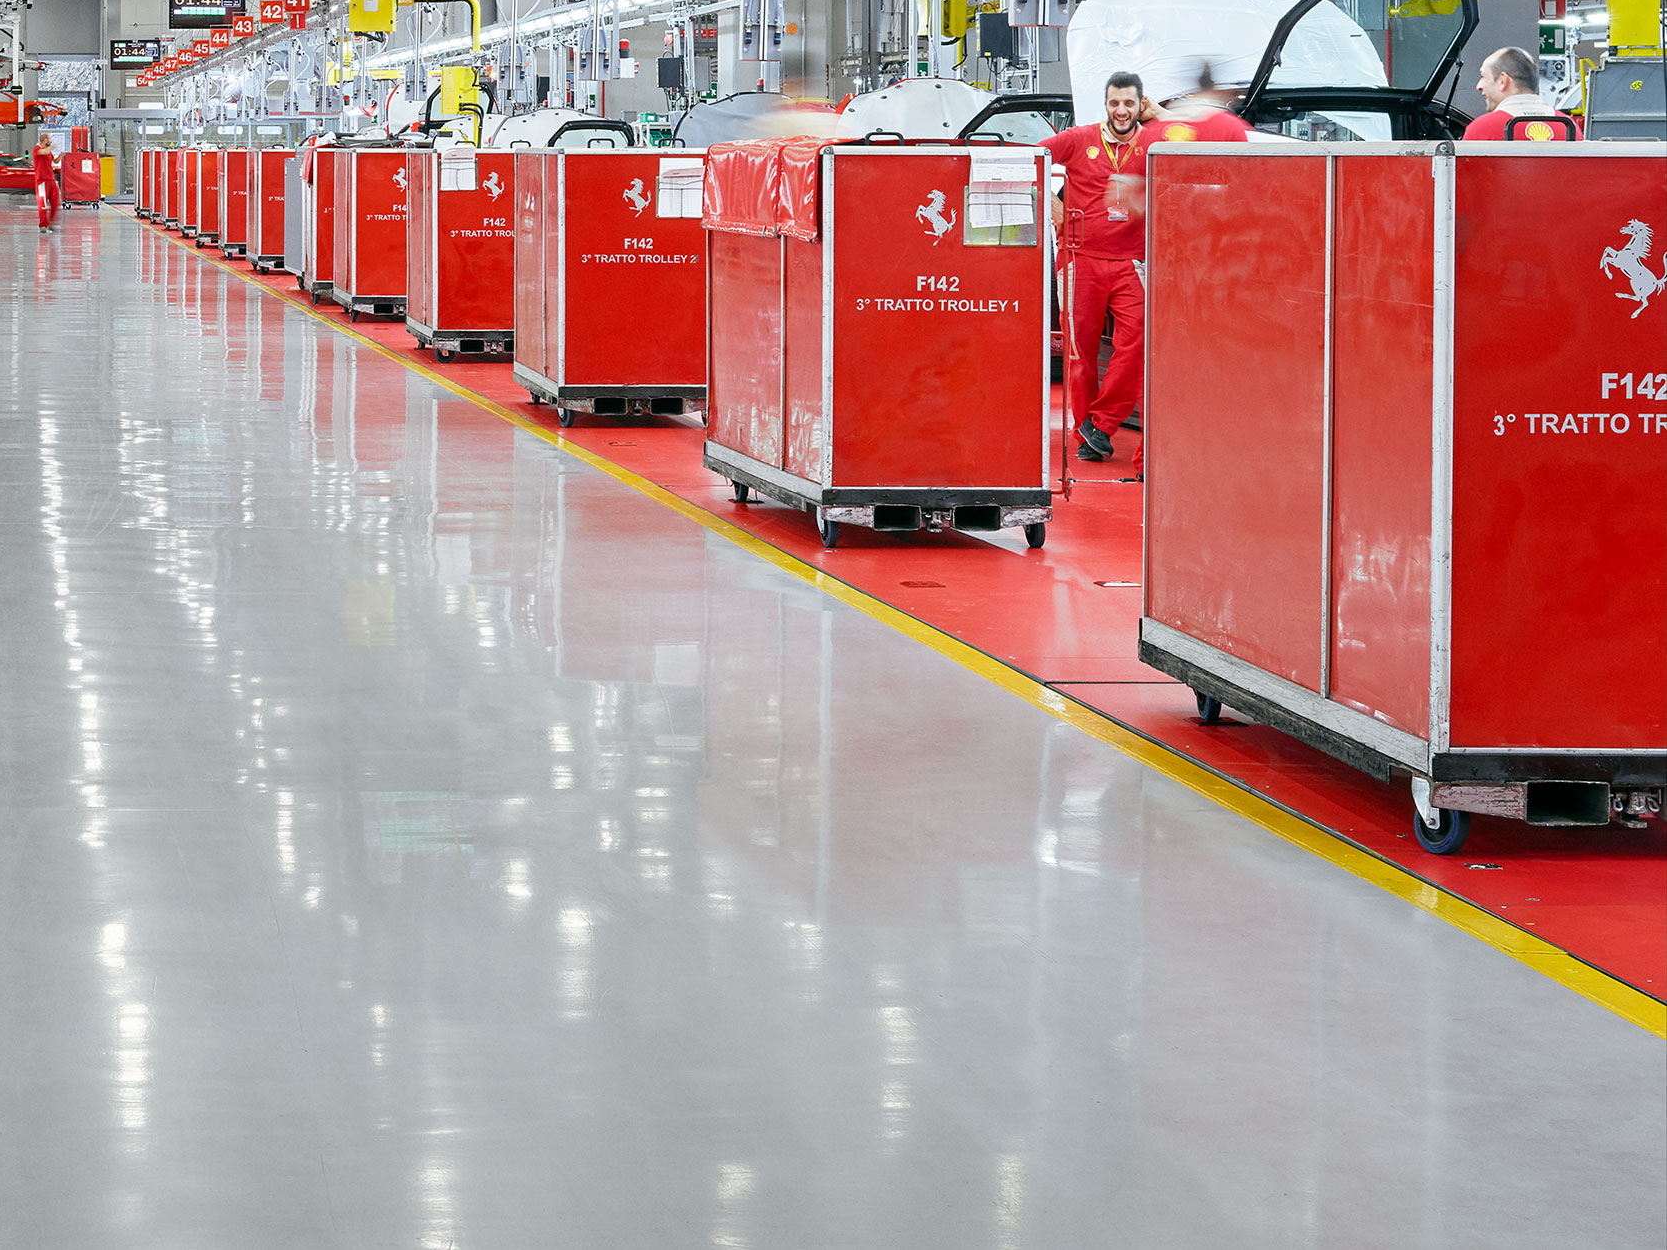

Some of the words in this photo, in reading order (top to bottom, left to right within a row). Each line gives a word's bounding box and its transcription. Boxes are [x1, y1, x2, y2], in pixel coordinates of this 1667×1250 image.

[262, 6, 282, 19] 42
[234, 20, 253, 33] 43
[212, 32, 229, 44] 44
[193, 42, 209, 54] 45
[178, 52, 193, 62] 46
[153, 65, 165, 74] 48
[165, 59, 177, 69] 47
[392, 204, 407, 212] F14
[483, 217, 506, 227] F142
[450, 229, 460, 238] 3°
[460, 230, 493, 238] TRATTO
[624, 237, 654, 250] F142
[581, 254, 592, 264] 3°
[594, 254, 637, 264] TRATTO
[638, 254, 687, 264] TROLLEY
[916, 275, 960, 292] F142
[856, 298, 871, 311] 3°
[874, 298, 934, 312] TRATTO
[938, 299, 1009, 312] TROLLEY
[1012, 300, 1020, 313] 1
[1601, 372, 1667, 401] F142
[1493, 413, 1517, 437] 3°
[1524, 413, 1631, 434] TRATTO
